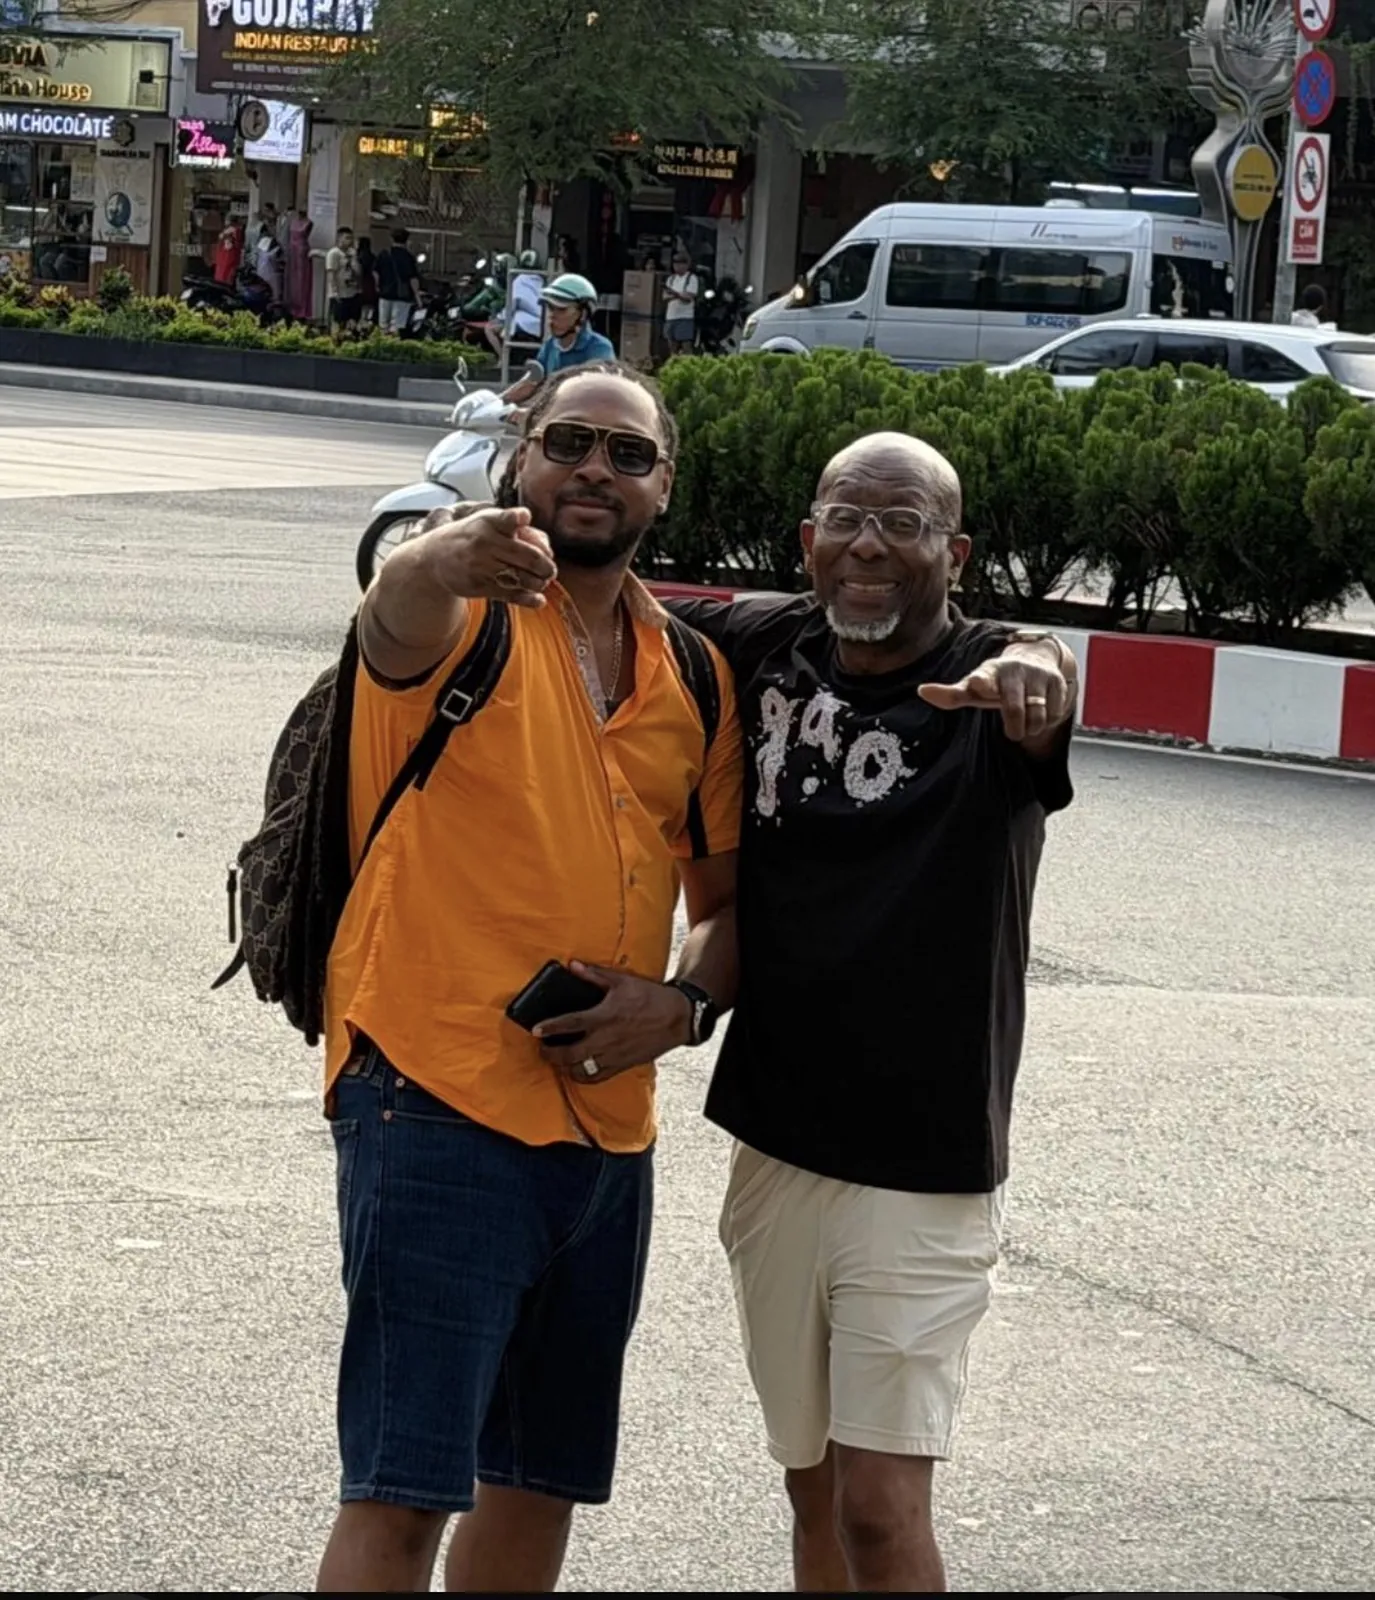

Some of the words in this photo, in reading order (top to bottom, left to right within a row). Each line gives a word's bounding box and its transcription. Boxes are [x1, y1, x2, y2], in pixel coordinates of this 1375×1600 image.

[235, 32, 281, 50] INDIAN
[36, 79, 91, 100] House
[20, 113, 112, 138] CHOCOLATE
